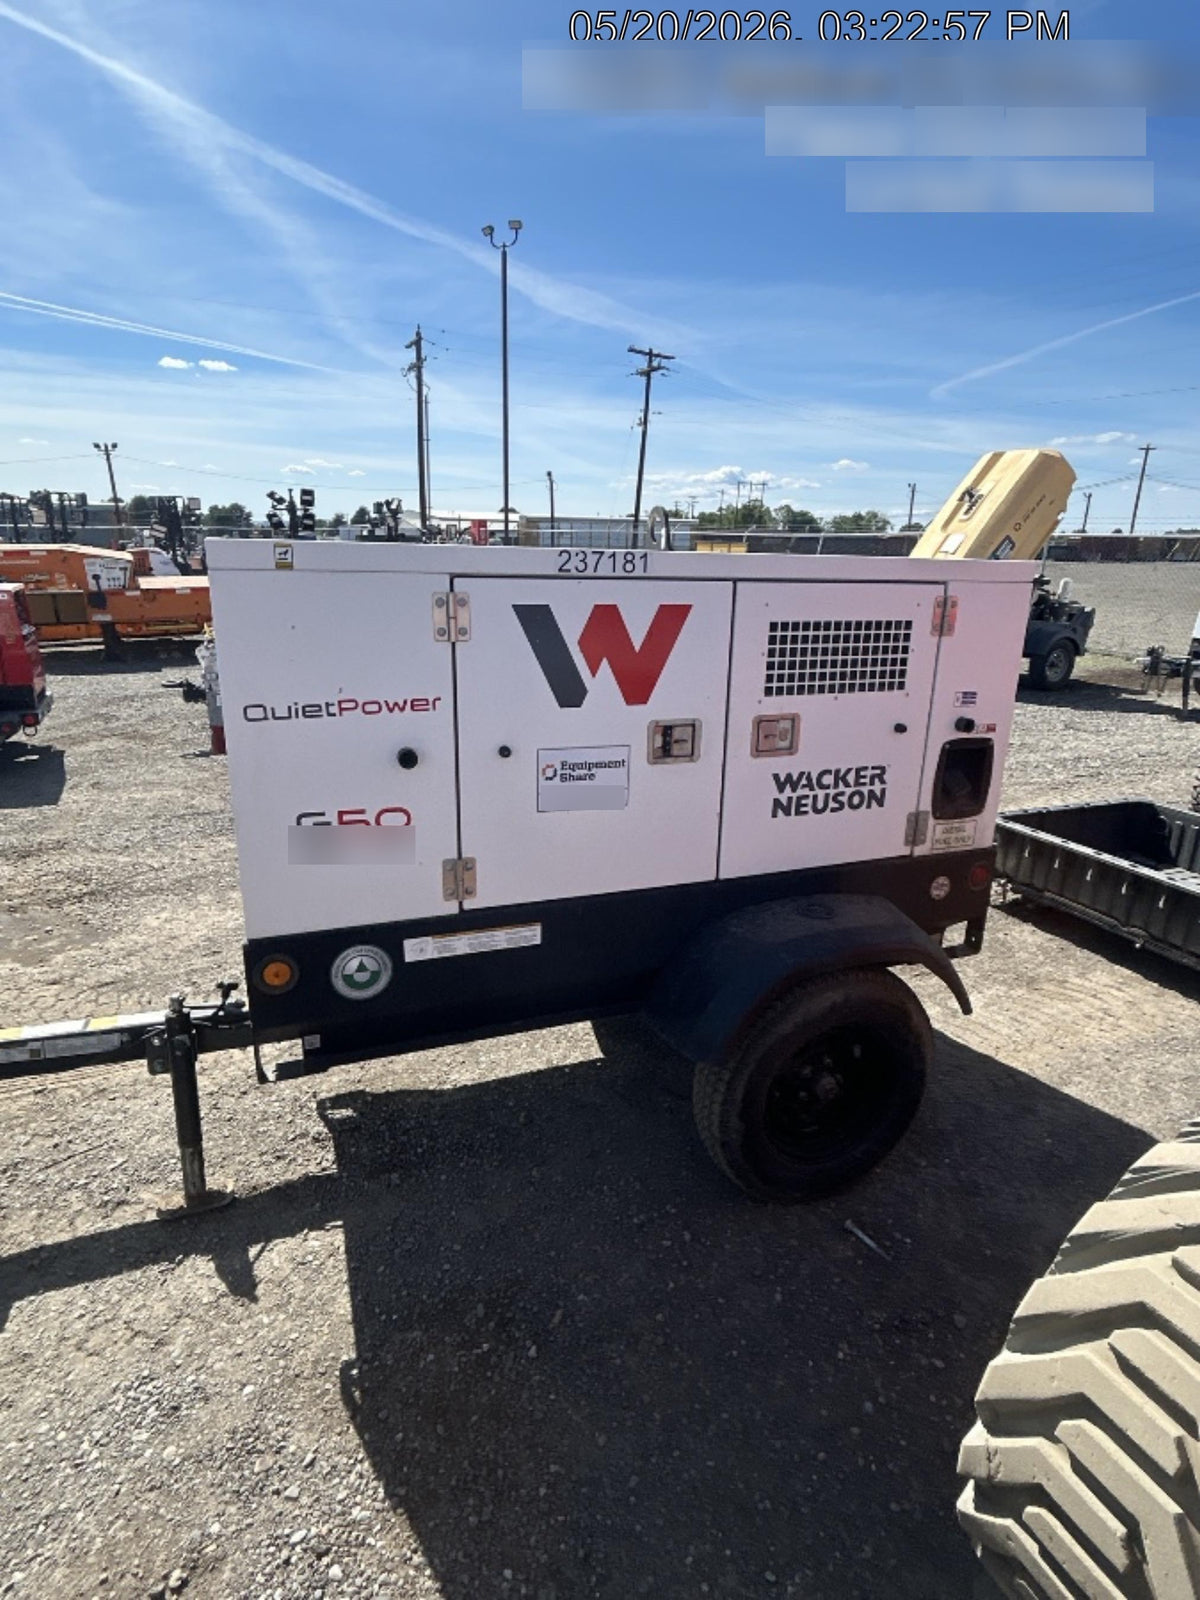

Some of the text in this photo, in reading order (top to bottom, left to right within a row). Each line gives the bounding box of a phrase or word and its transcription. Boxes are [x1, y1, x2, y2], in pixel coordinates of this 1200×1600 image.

[557, 549, 648, 573] 237181
[243, 696, 441, 722] QuietPower
[559, 773, 596, 783] Share
[560, 759, 626, 772] Equipment
[772, 765, 887, 794] WACKER
[771, 787, 886, 818] NEUSON
